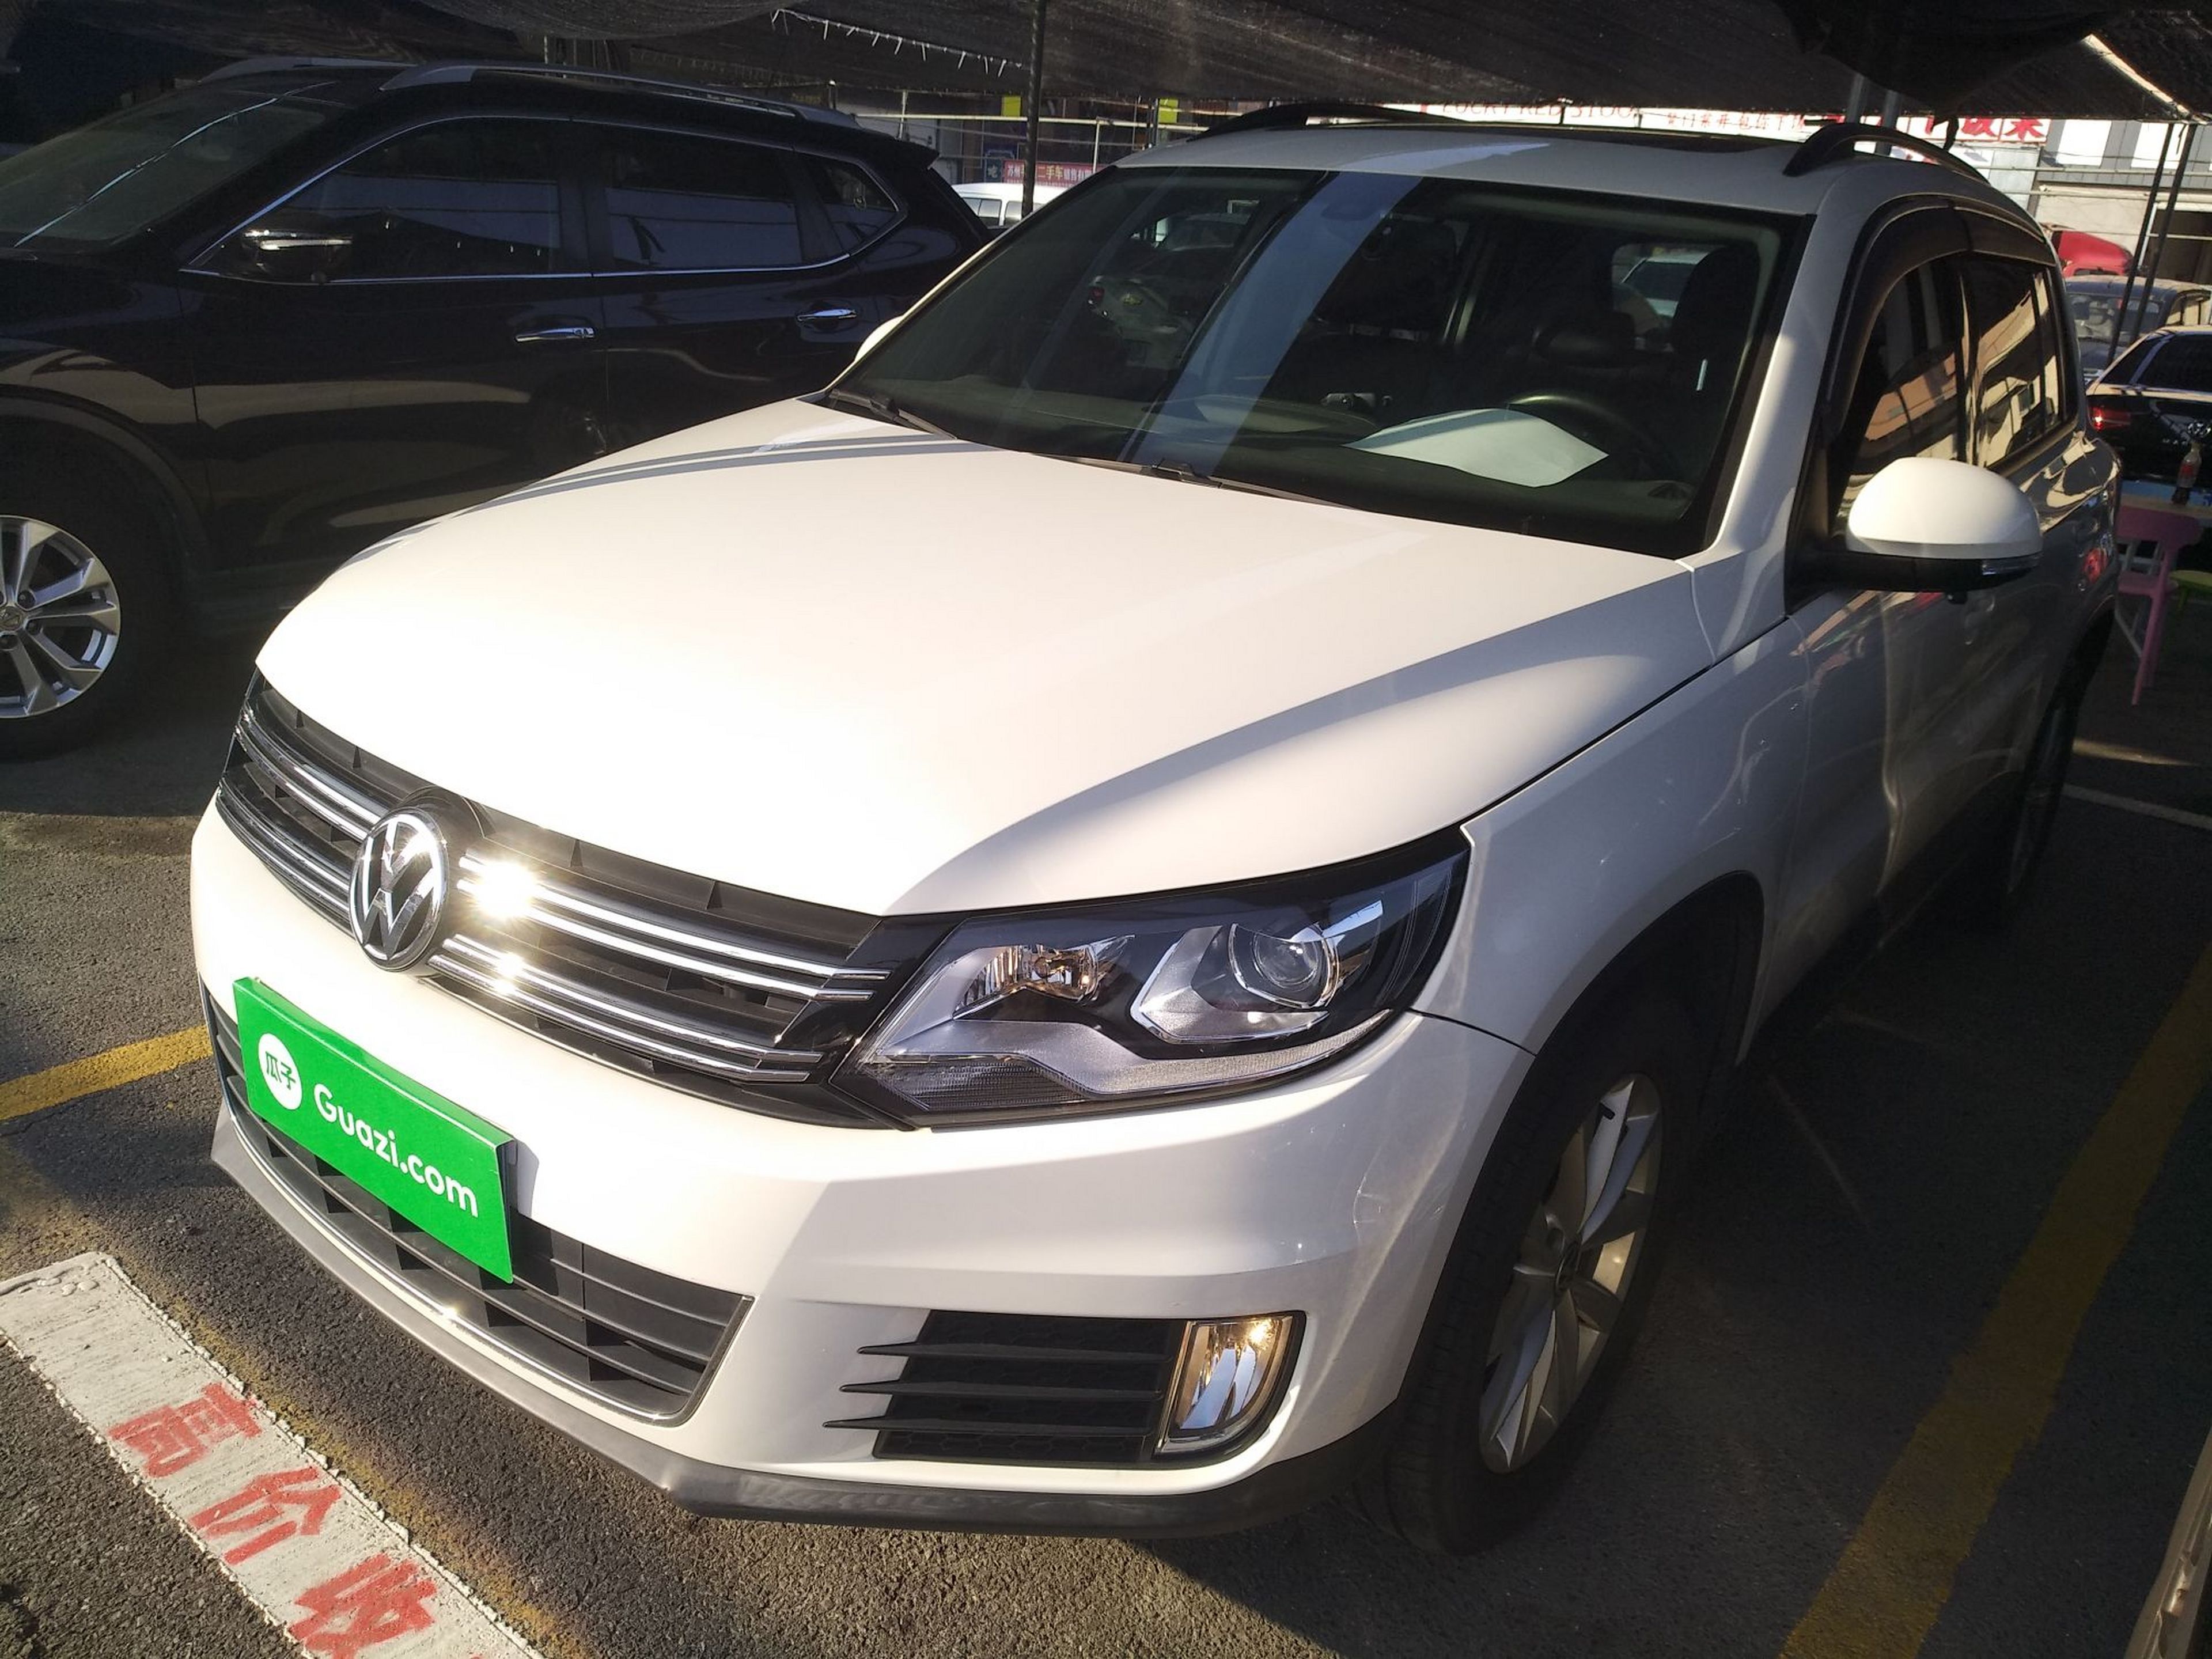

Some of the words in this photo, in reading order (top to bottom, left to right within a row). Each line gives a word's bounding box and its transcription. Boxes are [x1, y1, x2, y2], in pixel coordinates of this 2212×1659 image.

[265, 1051, 296, 1090] 瓜子
[314, 1084, 478, 1218] Guazi.com
[108, 1382, 478, 1659] 高价收
